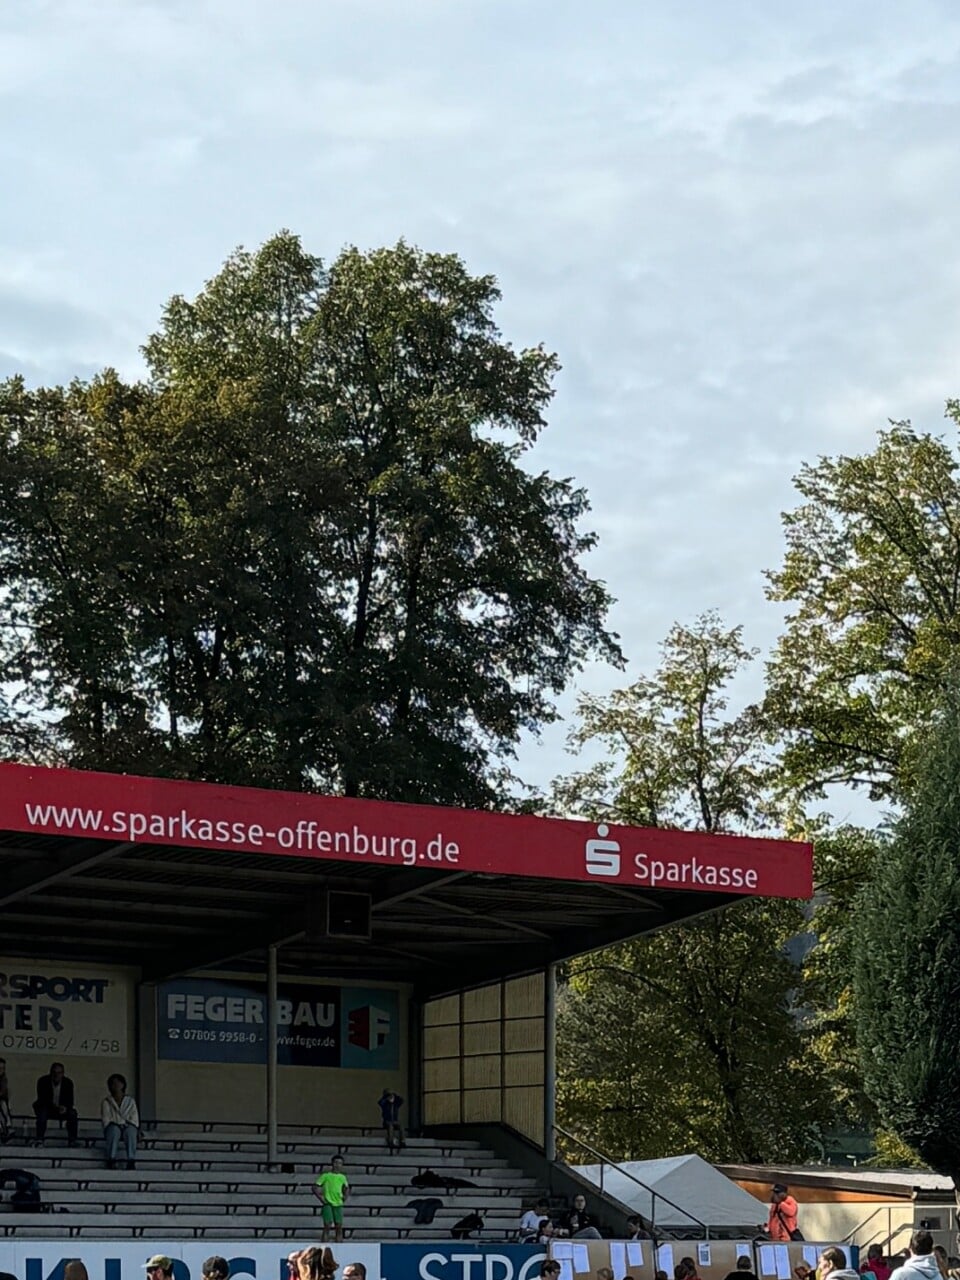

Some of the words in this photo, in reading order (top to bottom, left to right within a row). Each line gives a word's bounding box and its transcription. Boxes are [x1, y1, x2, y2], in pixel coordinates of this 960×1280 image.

[25, 803, 460, 866] www.sparkasse-offenburg.de
[634, 853, 758, 888] Sparkasse
[167, 993, 264, 1024] FEGER
[276, 1000, 335, 1028] BAU
[80, 1039, 120, 1053] 4758
